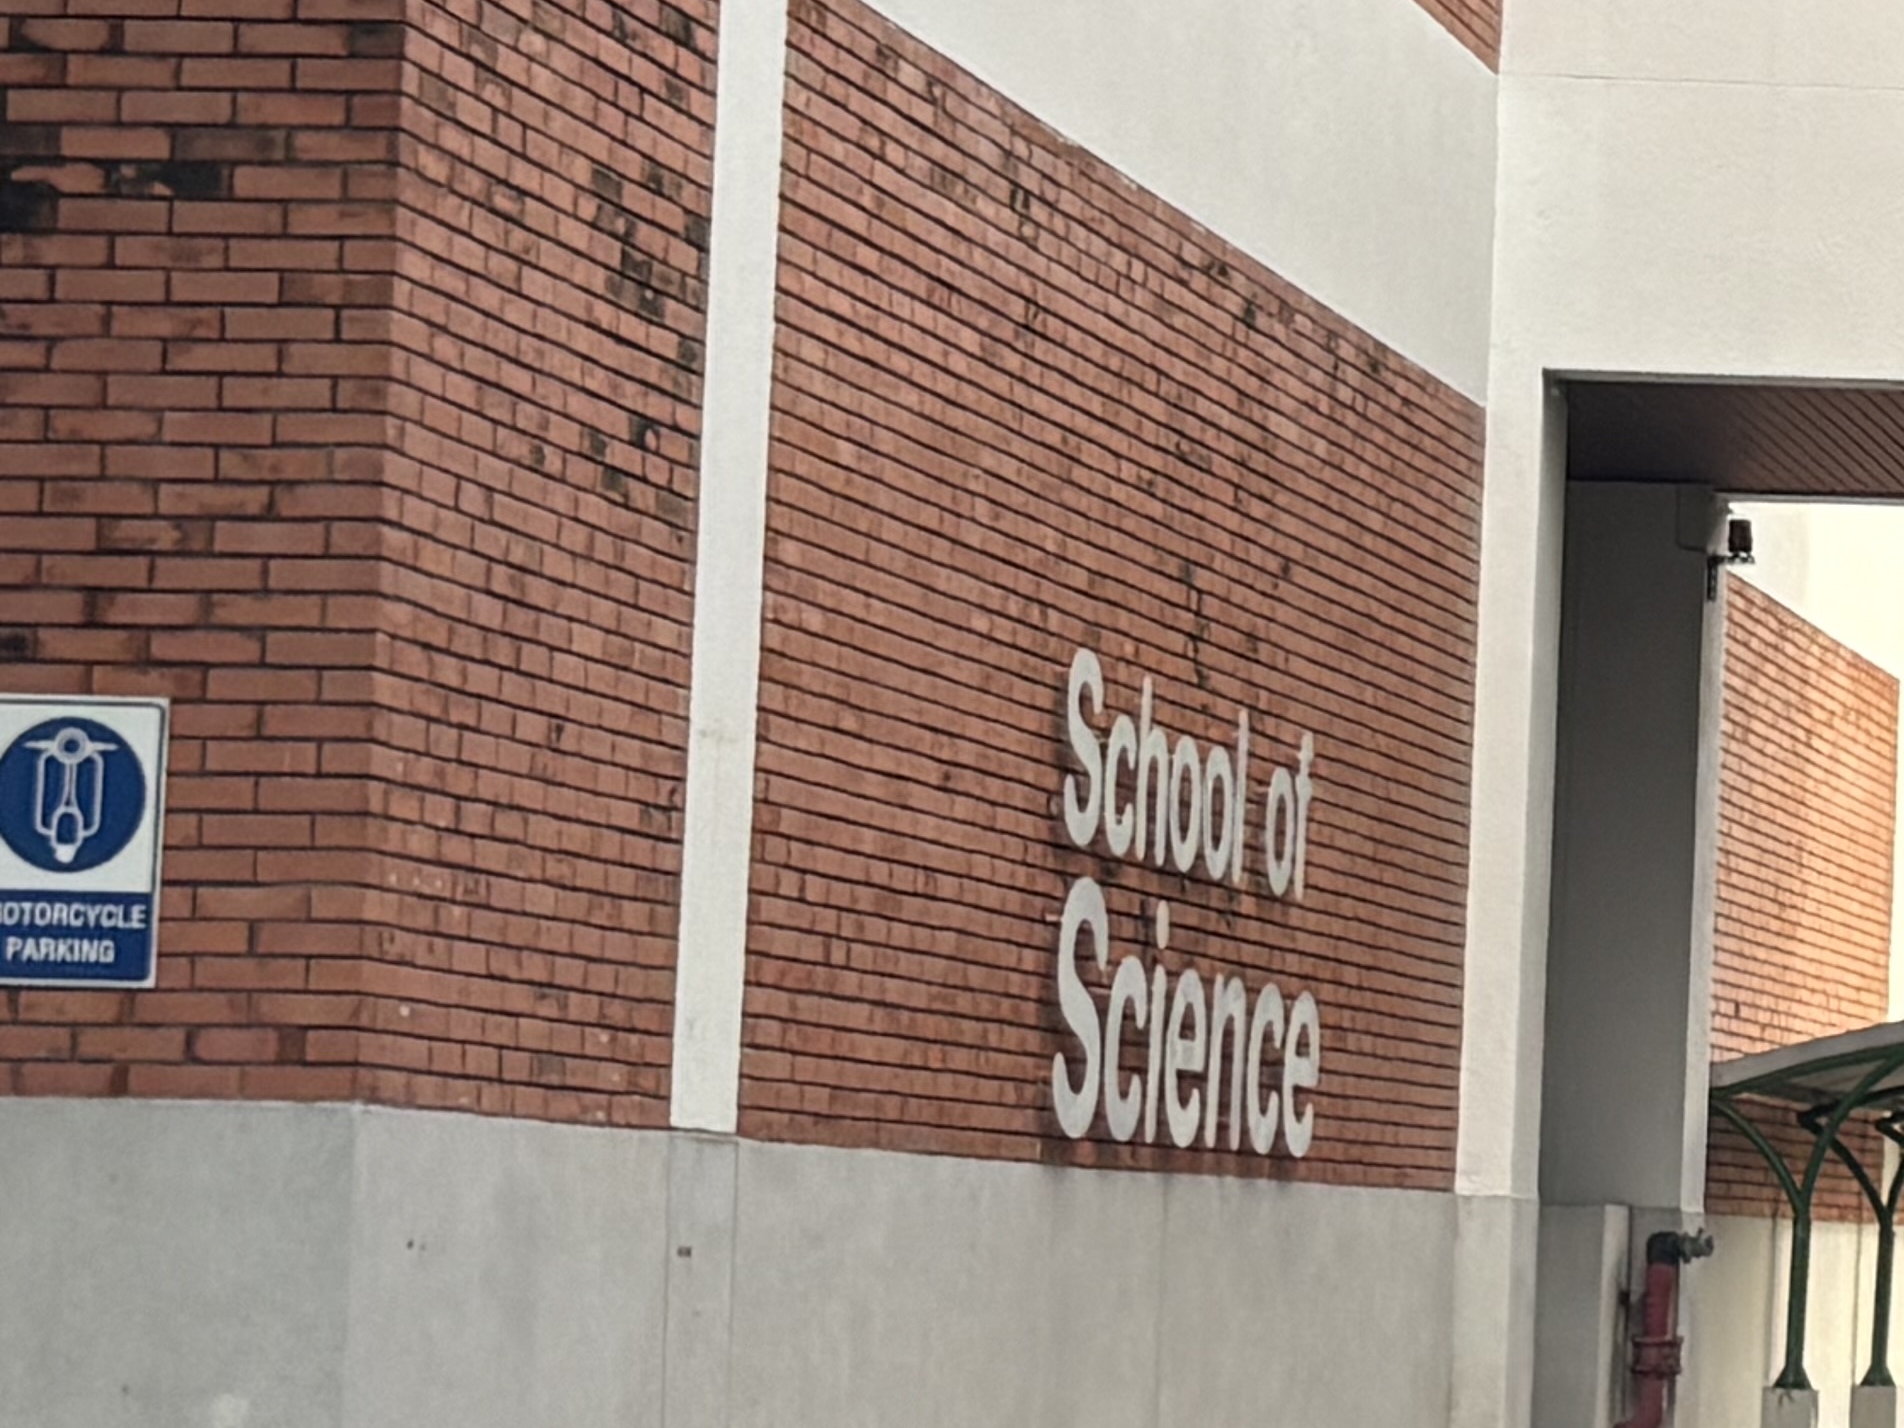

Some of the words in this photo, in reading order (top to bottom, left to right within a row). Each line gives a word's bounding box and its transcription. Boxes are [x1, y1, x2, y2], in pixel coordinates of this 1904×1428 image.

[1064, 647, 1248, 883] School
[1265, 730, 1314, 902] of
[0, 901, 147, 929] OTORCYCLE
[6, 936, 115, 963] PARKING
[1052, 876, 1320, 1157] Science
